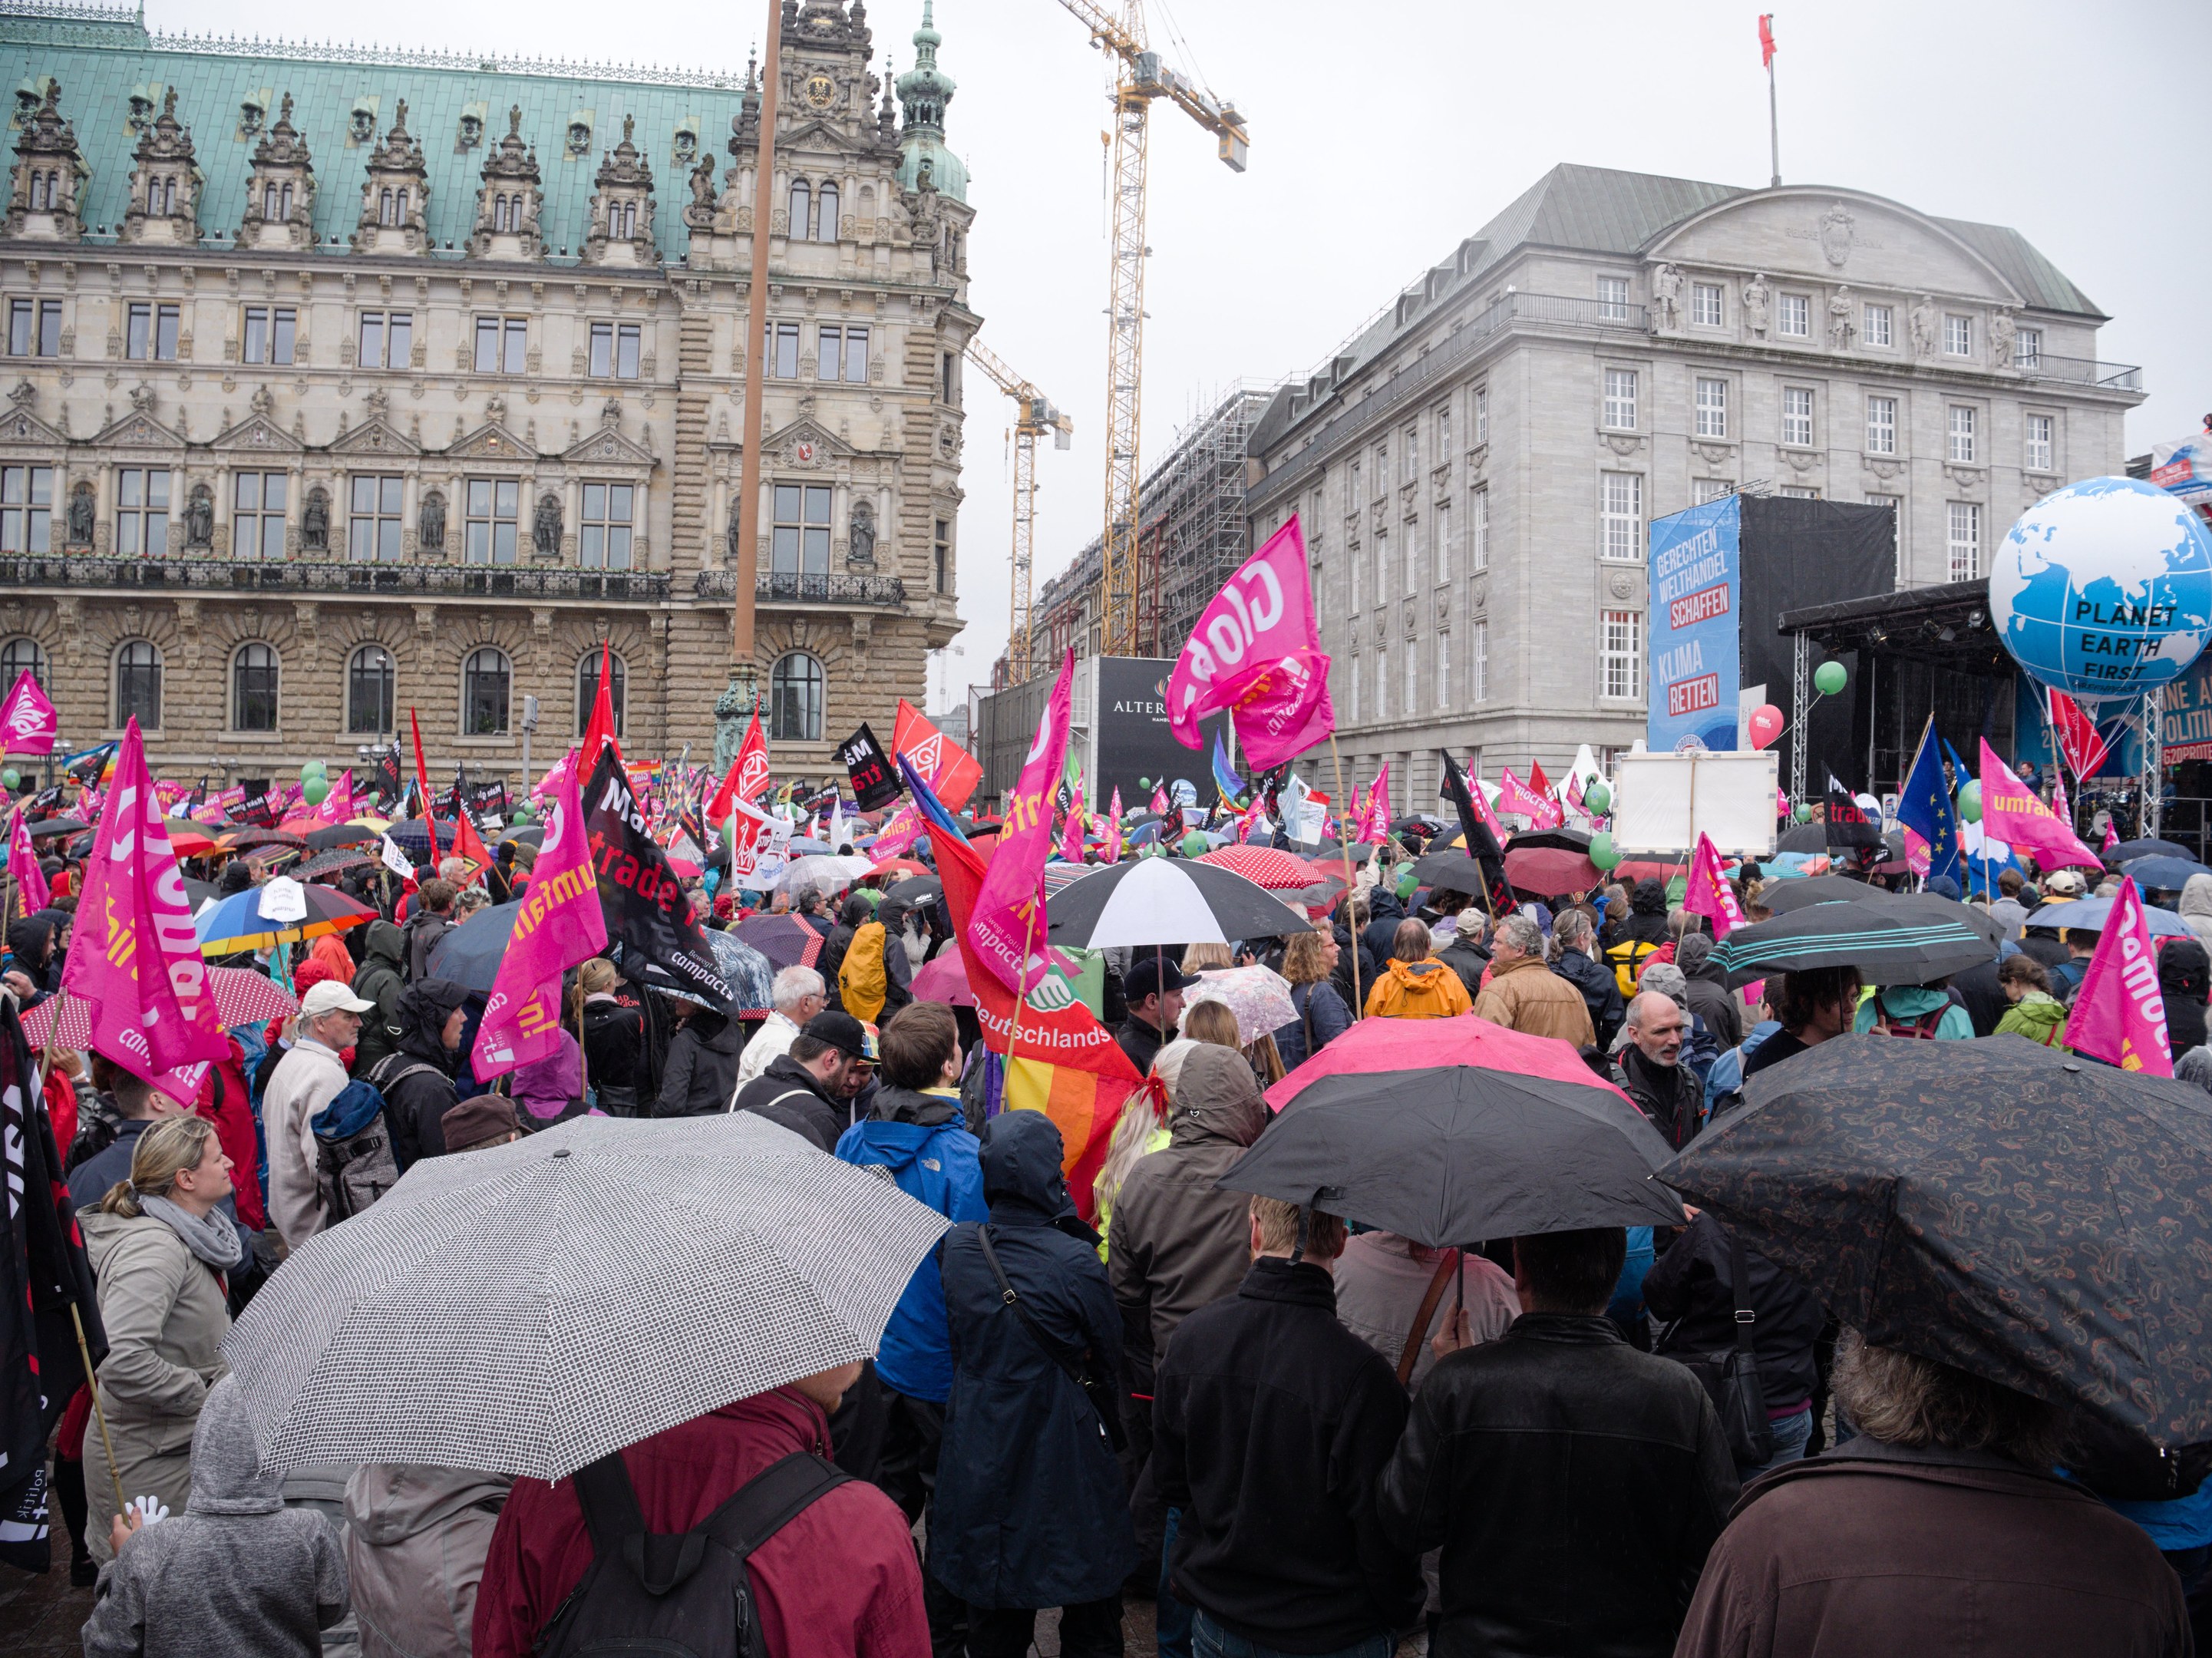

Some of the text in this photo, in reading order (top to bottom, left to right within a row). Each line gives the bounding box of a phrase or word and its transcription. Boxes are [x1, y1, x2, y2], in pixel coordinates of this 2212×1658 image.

[1657, 525, 1718, 578] GERECHTEN
[1659, 551, 1728, 604] WELTHANDEL
[1671, 586, 1728, 629] SCHAFFEN
[2075, 601, 2177, 627] PLANET
[1658, 639, 1703, 685] KLIMA
[2081, 633, 2163, 657] EARTH
[2084, 662, 2147, 681] FIRST
[1670, 675, 1718, 715] RETTEN
